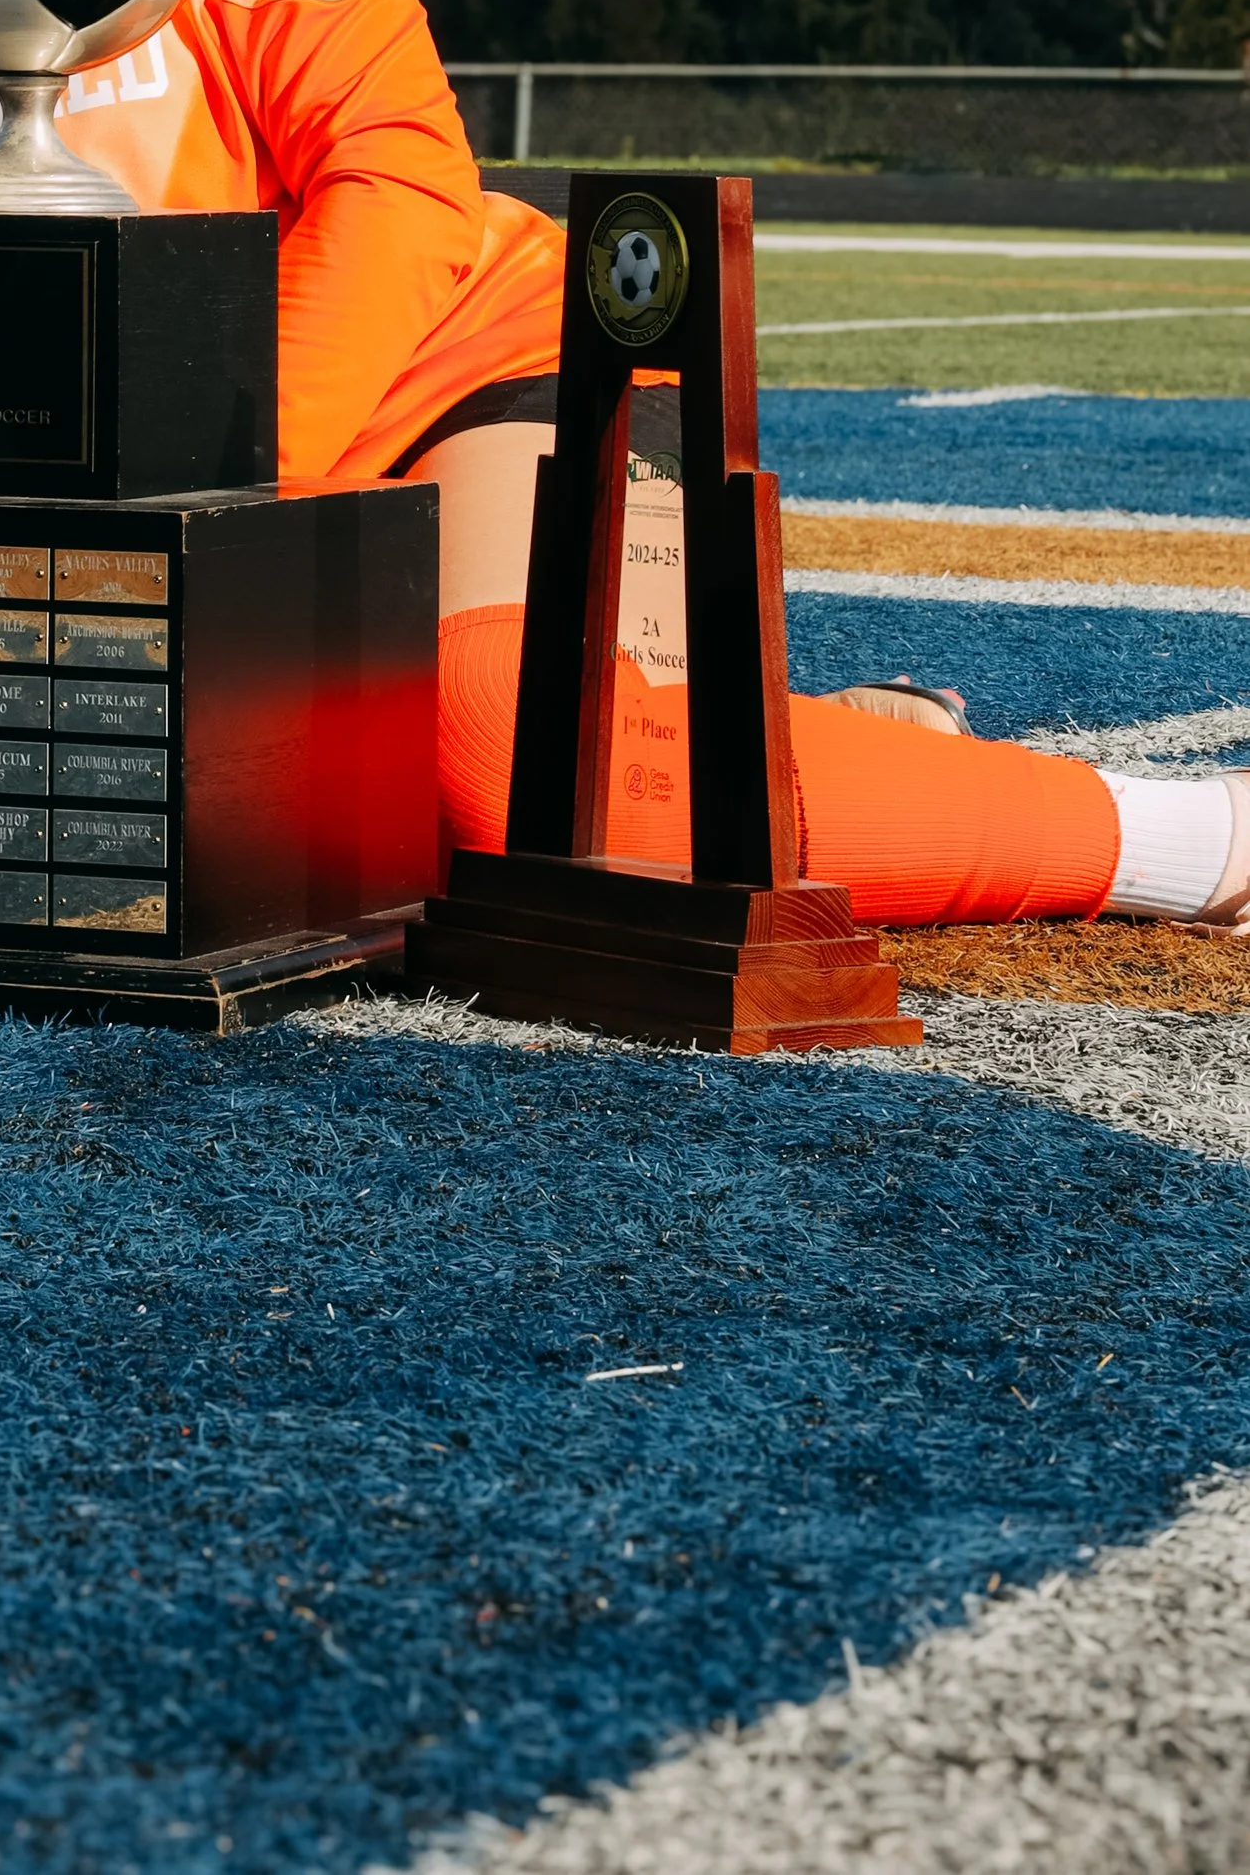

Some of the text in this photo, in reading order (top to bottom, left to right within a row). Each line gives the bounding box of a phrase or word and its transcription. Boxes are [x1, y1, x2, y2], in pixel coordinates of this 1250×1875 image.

[634, 460, 674, 480] WIAA
[627, 543, 680, 567] 2024-25
[64, 555, 158, 574] NACHES VALLEY
[642, 617, 661, 637] 2A
[96, 644, 126, 658] 2006
[611, 641, 686, 669] Girls Socce
[75, 692, 148, 708] INTERLAKE
[99, 712, 123, 725] 2011
[641, 717, 677, 740] Place
[67, 755, 151, 773] COLUMBIA RIVER
[97, 773, 122, 786] 2016
[67, 821, 151, 839] COLUMBIA RIVER
[95, 839, 124, 853] 2022
